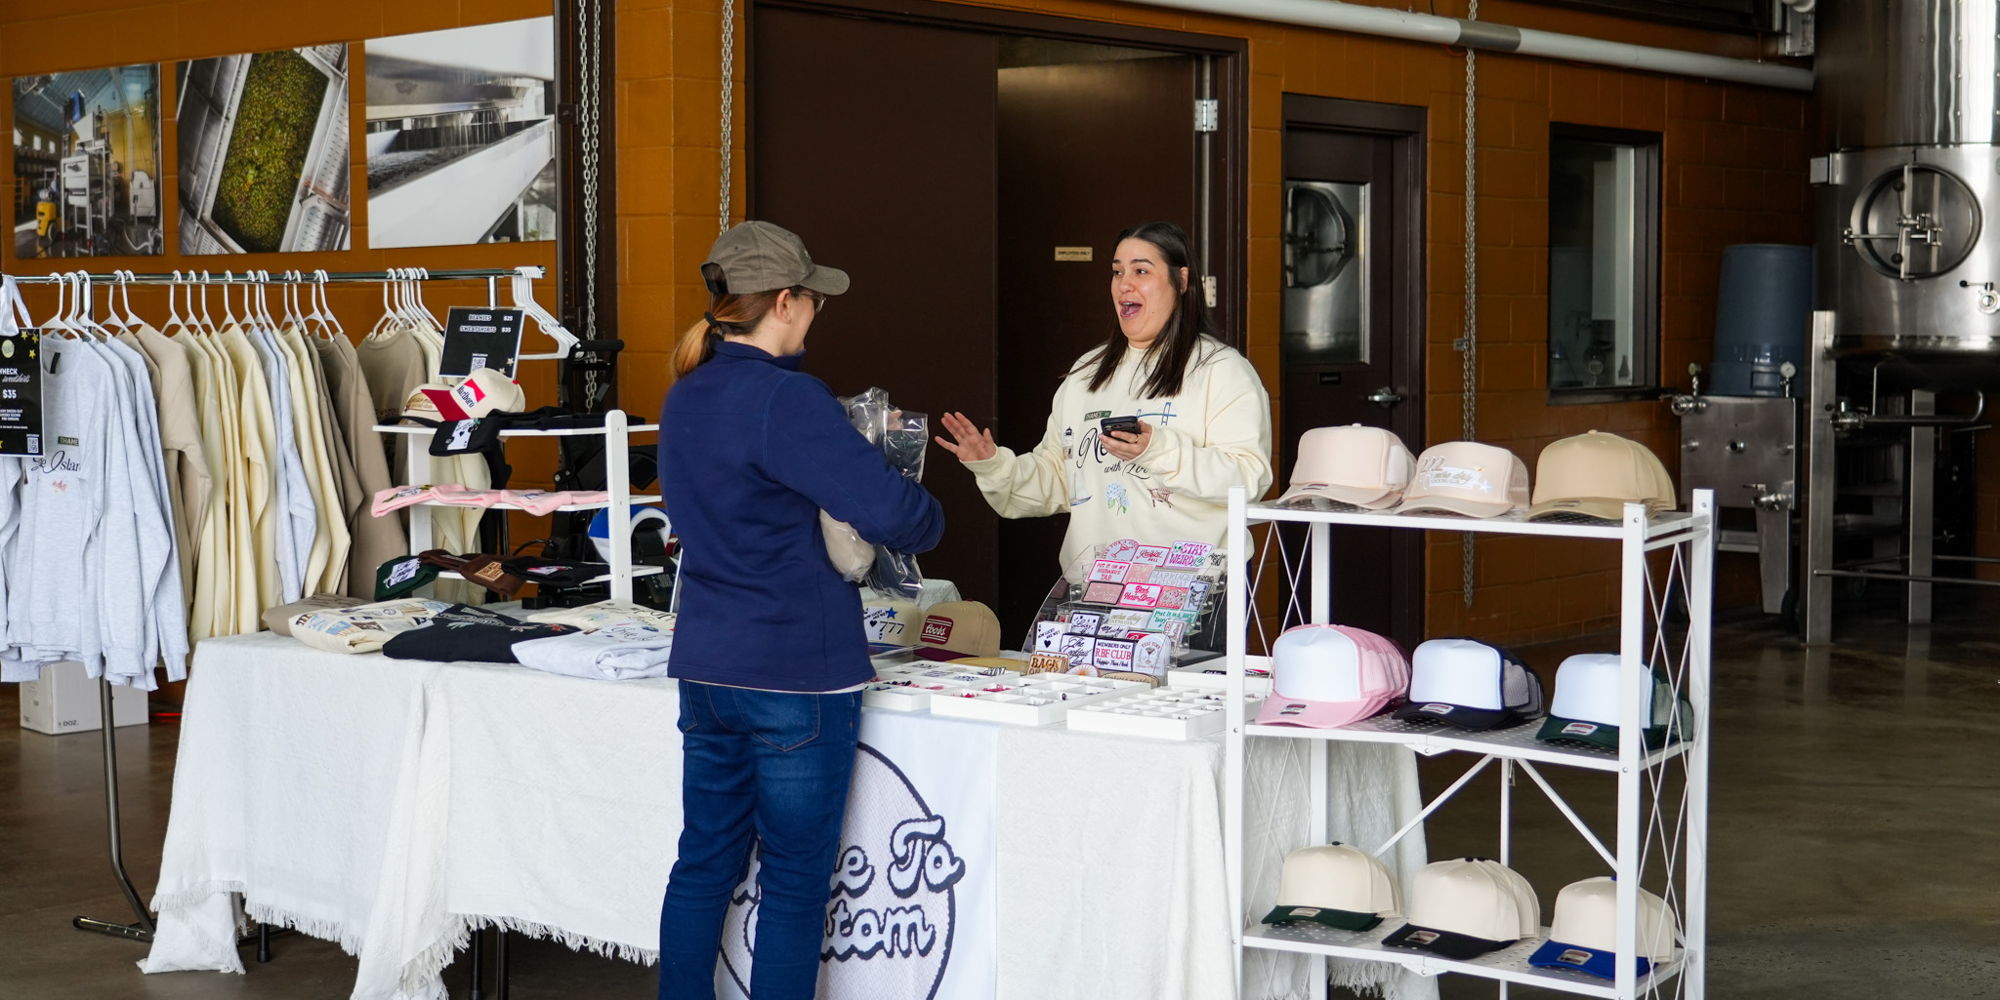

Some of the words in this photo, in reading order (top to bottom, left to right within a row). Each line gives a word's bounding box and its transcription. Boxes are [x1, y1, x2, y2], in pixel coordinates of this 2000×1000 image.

[2, 389, 17, 399] $35
[456, 385, 475, 408] Marlboro
[1104, 460, 1121, 473] with
[1181, 542, 1206, 555] STAY
[1169, 552, 1194, 566] WEIRD
[879, 621, 904, 634] 777
[1095, 648, 1111, 658] RBF
[1111, 650, 1132, 660] CLUB
[888, 814, 966, 899] To
